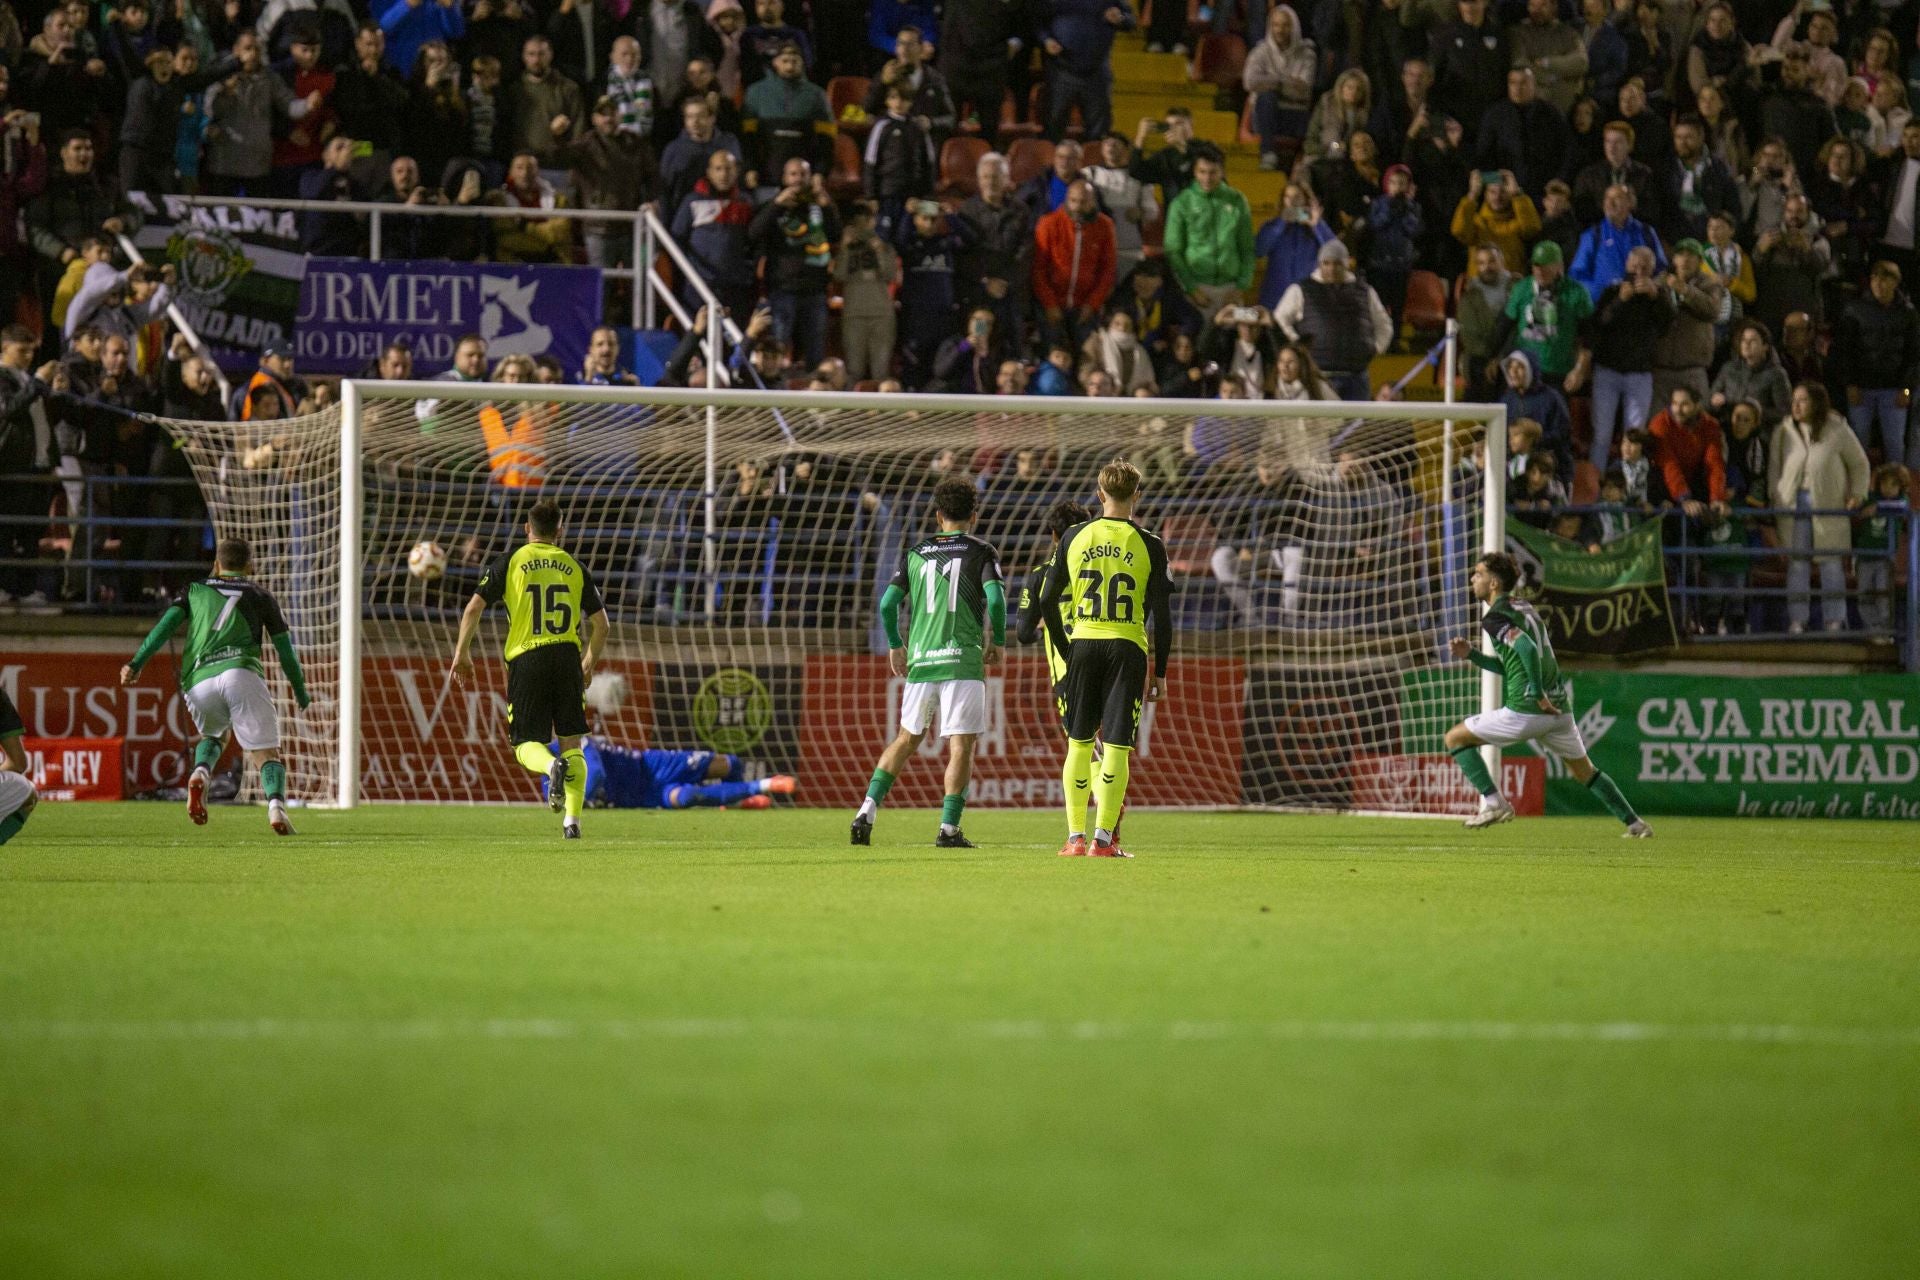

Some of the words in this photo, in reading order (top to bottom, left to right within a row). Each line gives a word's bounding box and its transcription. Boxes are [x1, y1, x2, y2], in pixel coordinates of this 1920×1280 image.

[520, 558, 574, 576] PERRAUD
[1081, 541, 1121, 563] JESÚS
[1122, 553, 1134, 567] R.
[920, 557, 962, 614] 11
[1077, 569, 1136, 621] 36
[212, 588, 243, 632] 7
[525, 583, 572, 635] 15
[1637, 698, 1751, 741] CAJA
[1760, 698, 1919, 738] RURAL
[62, 750, 102, 786] REY
[1503, 763, 1527, 798] EY
[1637, 742, 1920, 784] EXTREMAD
